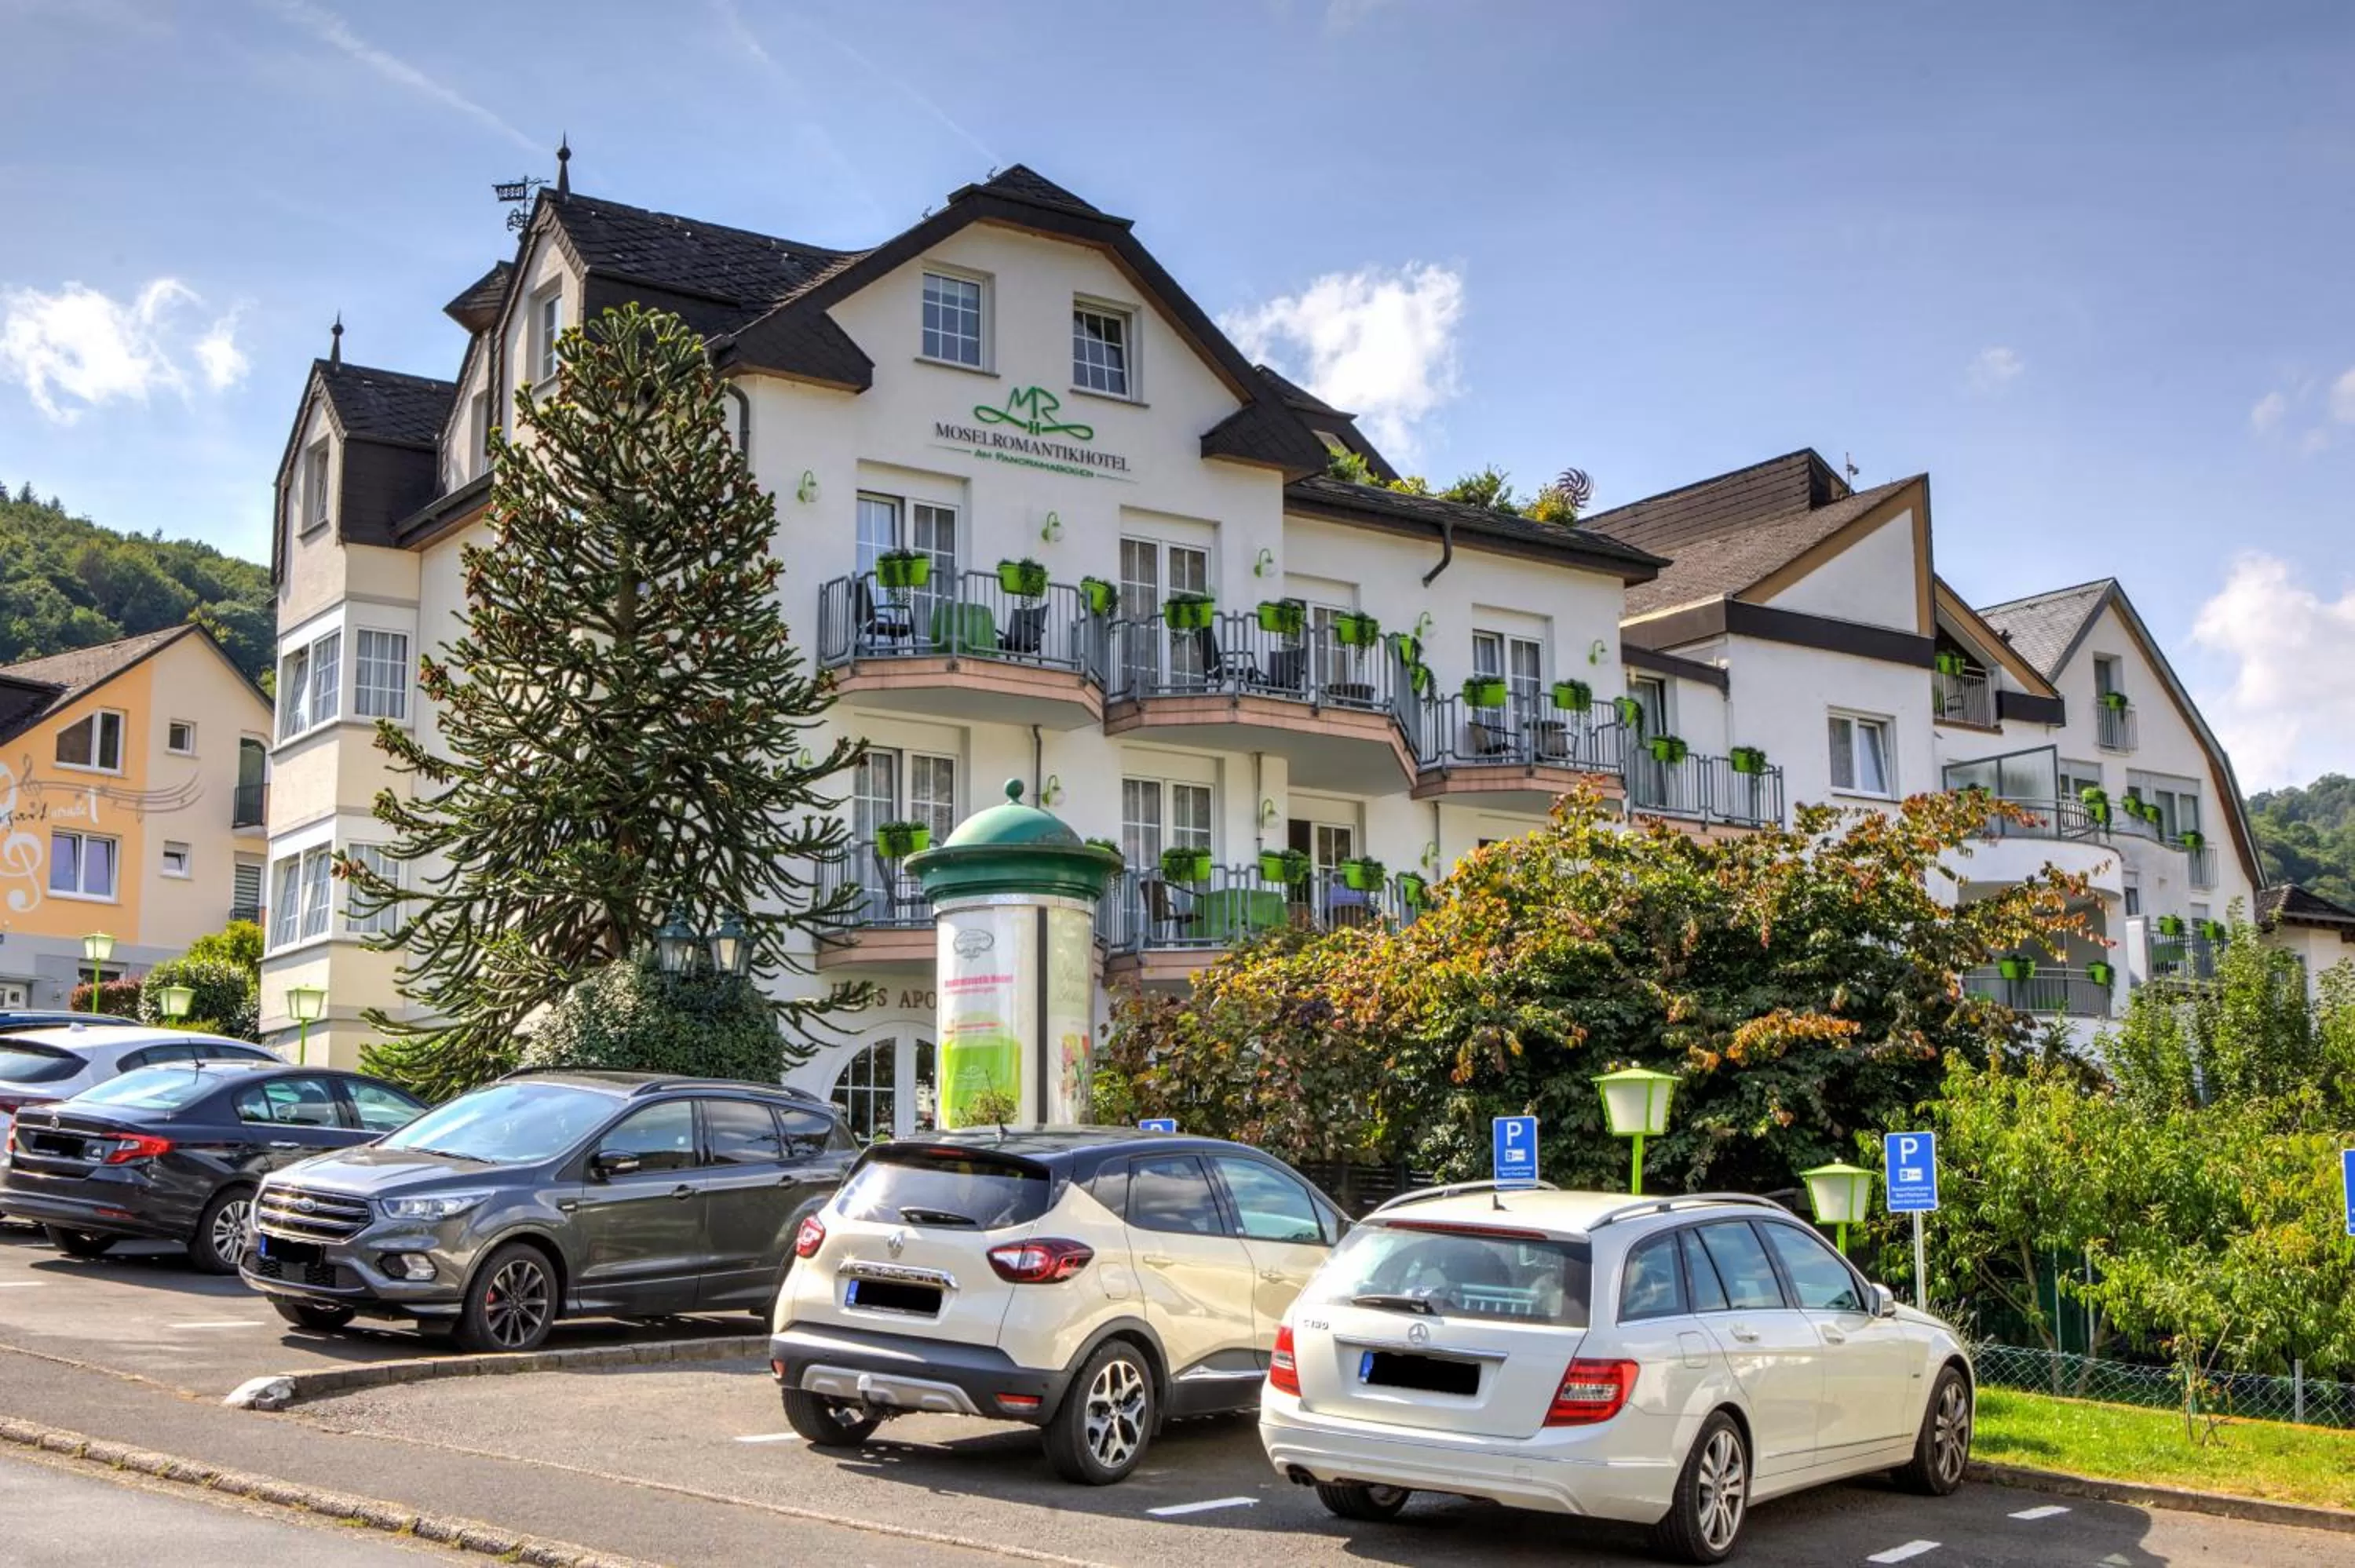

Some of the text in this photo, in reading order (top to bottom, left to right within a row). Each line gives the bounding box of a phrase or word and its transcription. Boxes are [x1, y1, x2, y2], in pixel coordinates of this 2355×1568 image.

[935, 422, 1130, 472] MOSELROMANTIKHOTEL
[1506, 1121, 1523, 1147] P
[1900, 1137, 1919, 1165] P
